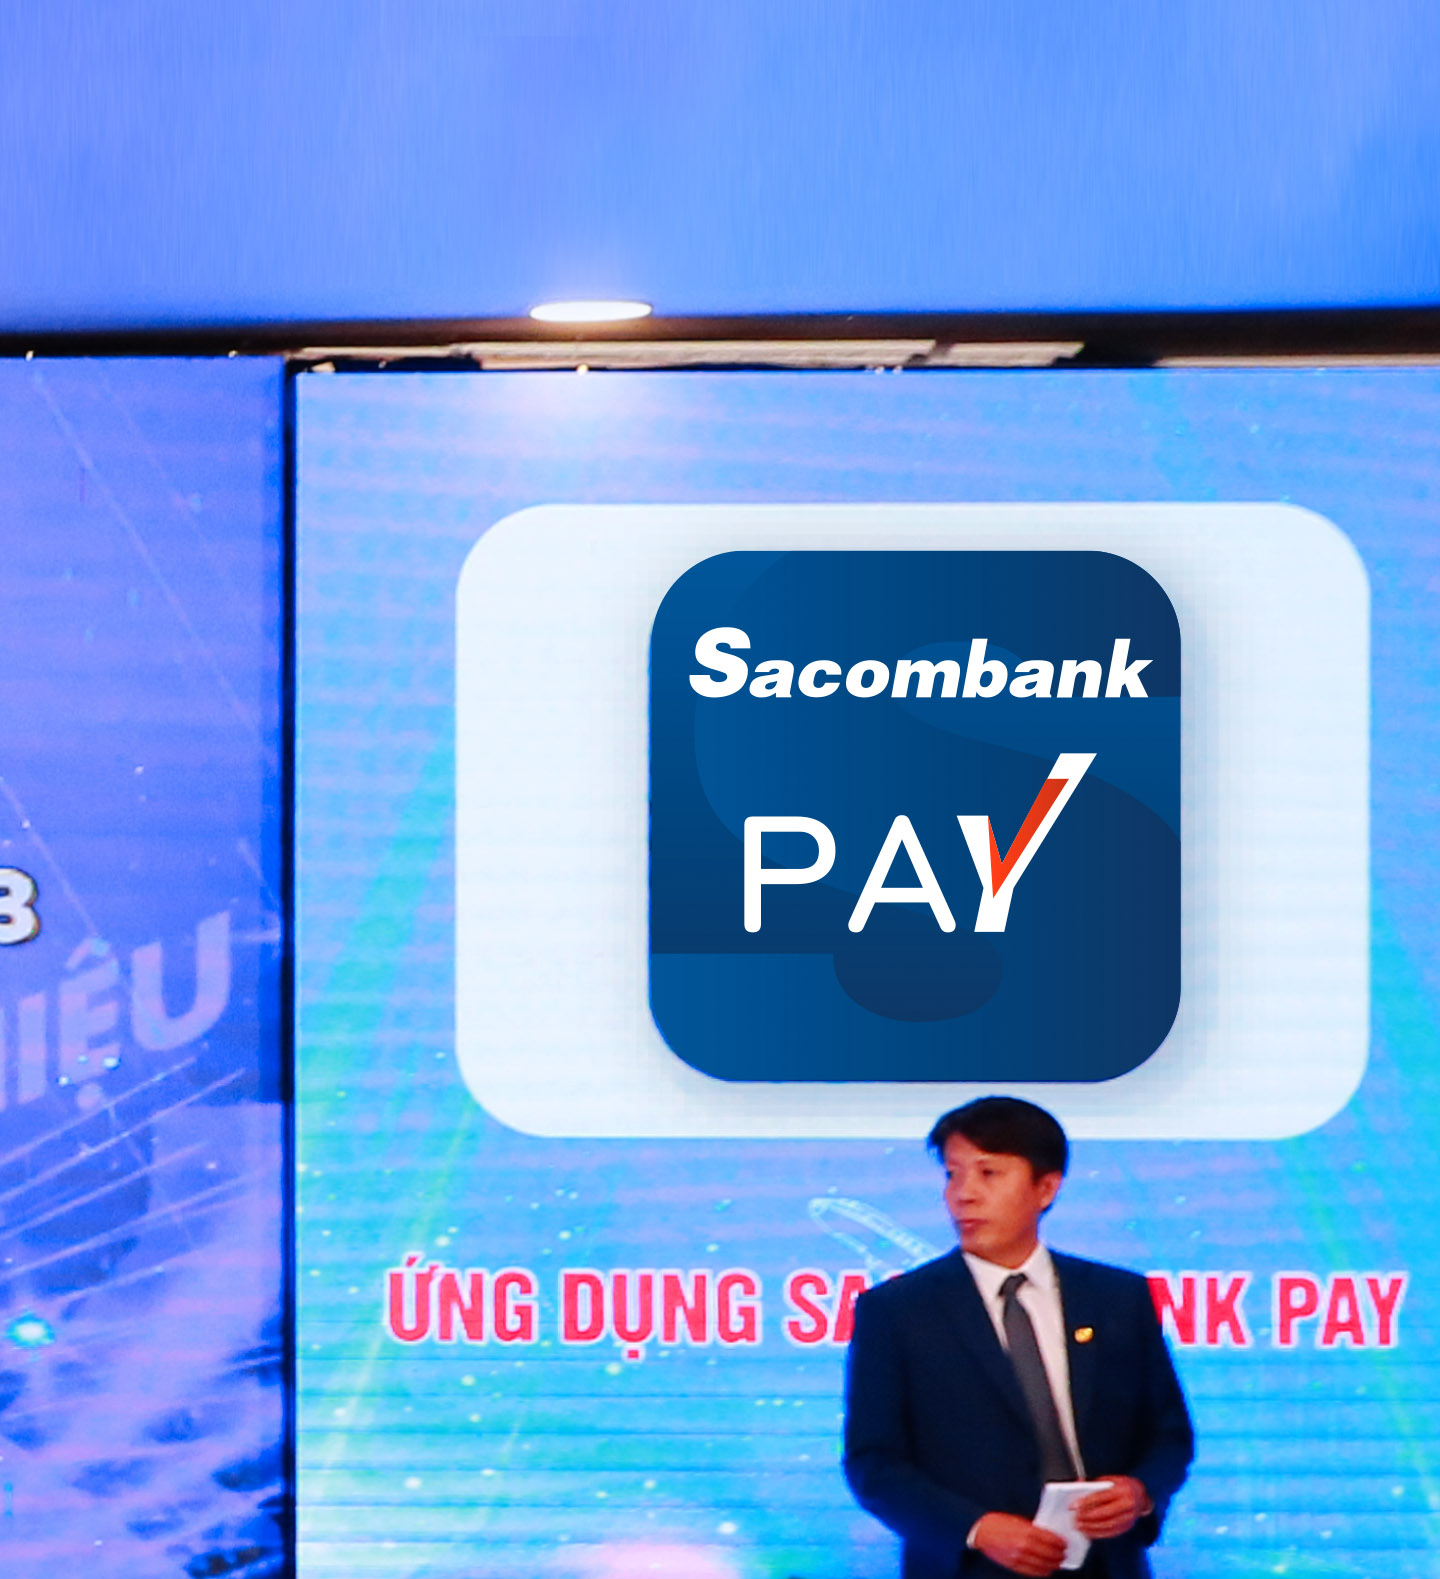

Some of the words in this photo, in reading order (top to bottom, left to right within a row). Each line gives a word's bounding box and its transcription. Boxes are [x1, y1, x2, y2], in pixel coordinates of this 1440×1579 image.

[689, 626, 1154, 699] Sacombank
[743, 753, 1097, 933] PAY
[386, 1253, 536, 1346] ỨNG
[562, 1269, 761, 1361] DỤNG
[1273, 1270, 1408, 1348] PAY
